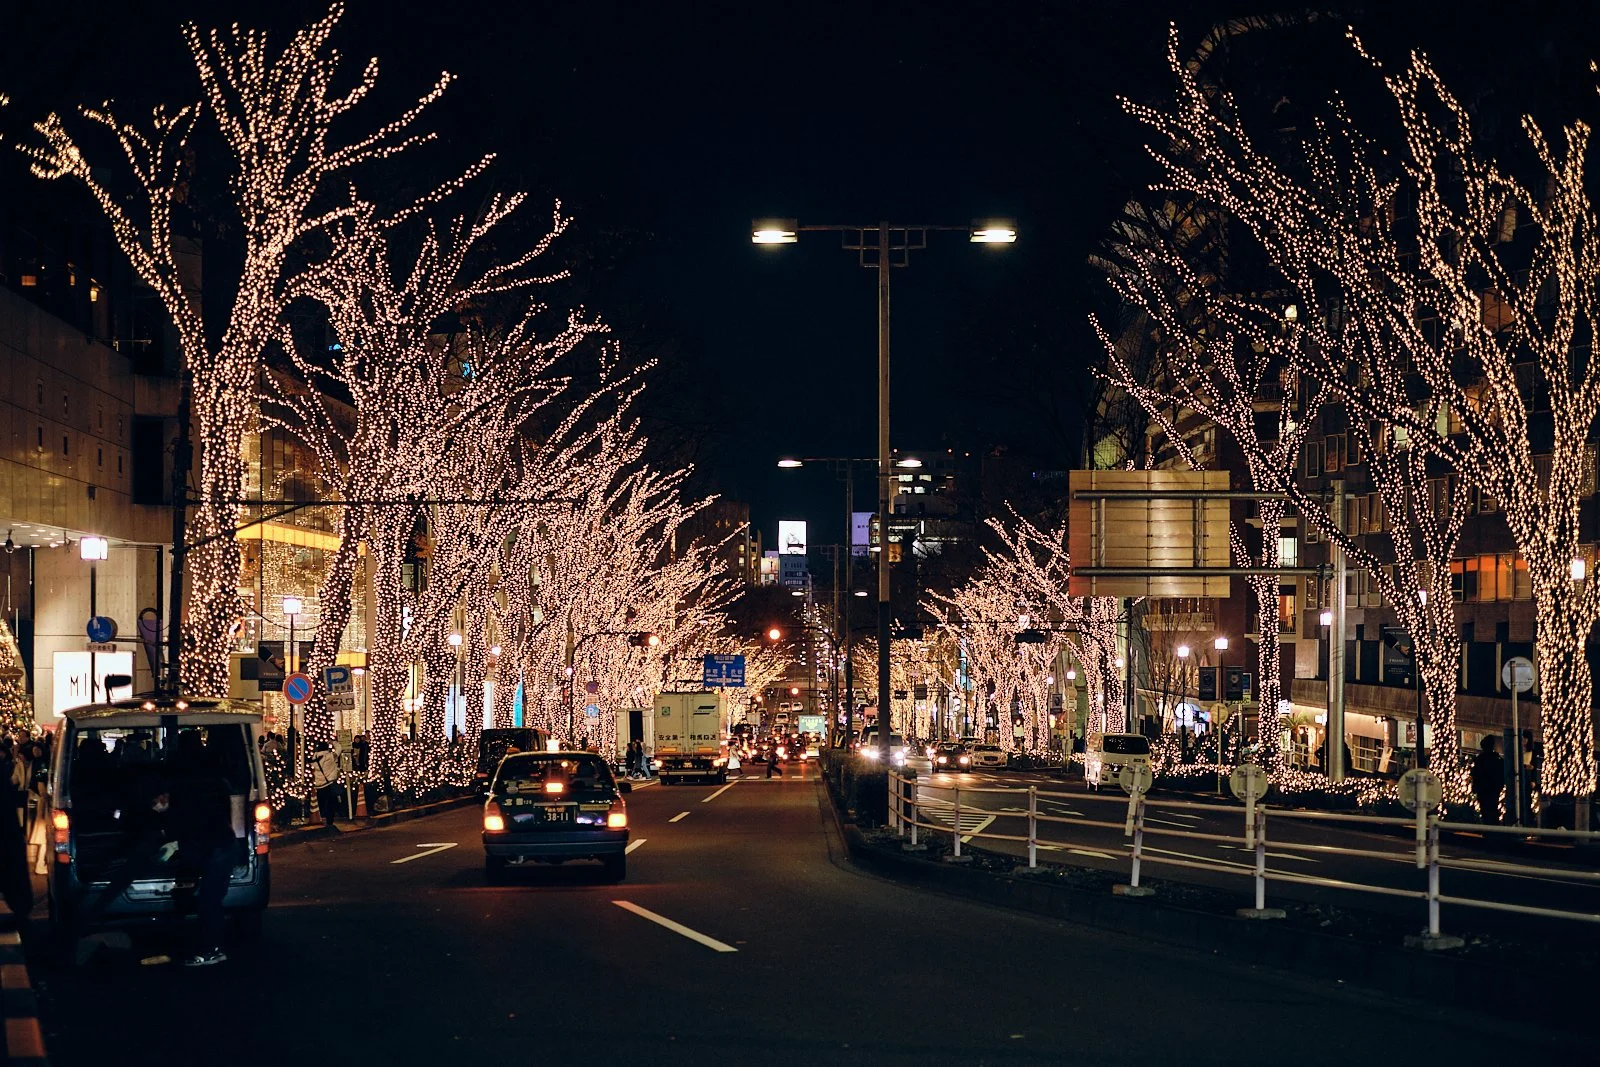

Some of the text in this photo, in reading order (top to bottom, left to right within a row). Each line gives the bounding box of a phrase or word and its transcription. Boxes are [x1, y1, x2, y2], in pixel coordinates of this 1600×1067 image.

[326, 667, 348, 692] P
[338, 698, 354, 706] 入口
[547, 812, 569, 822] 38-11
